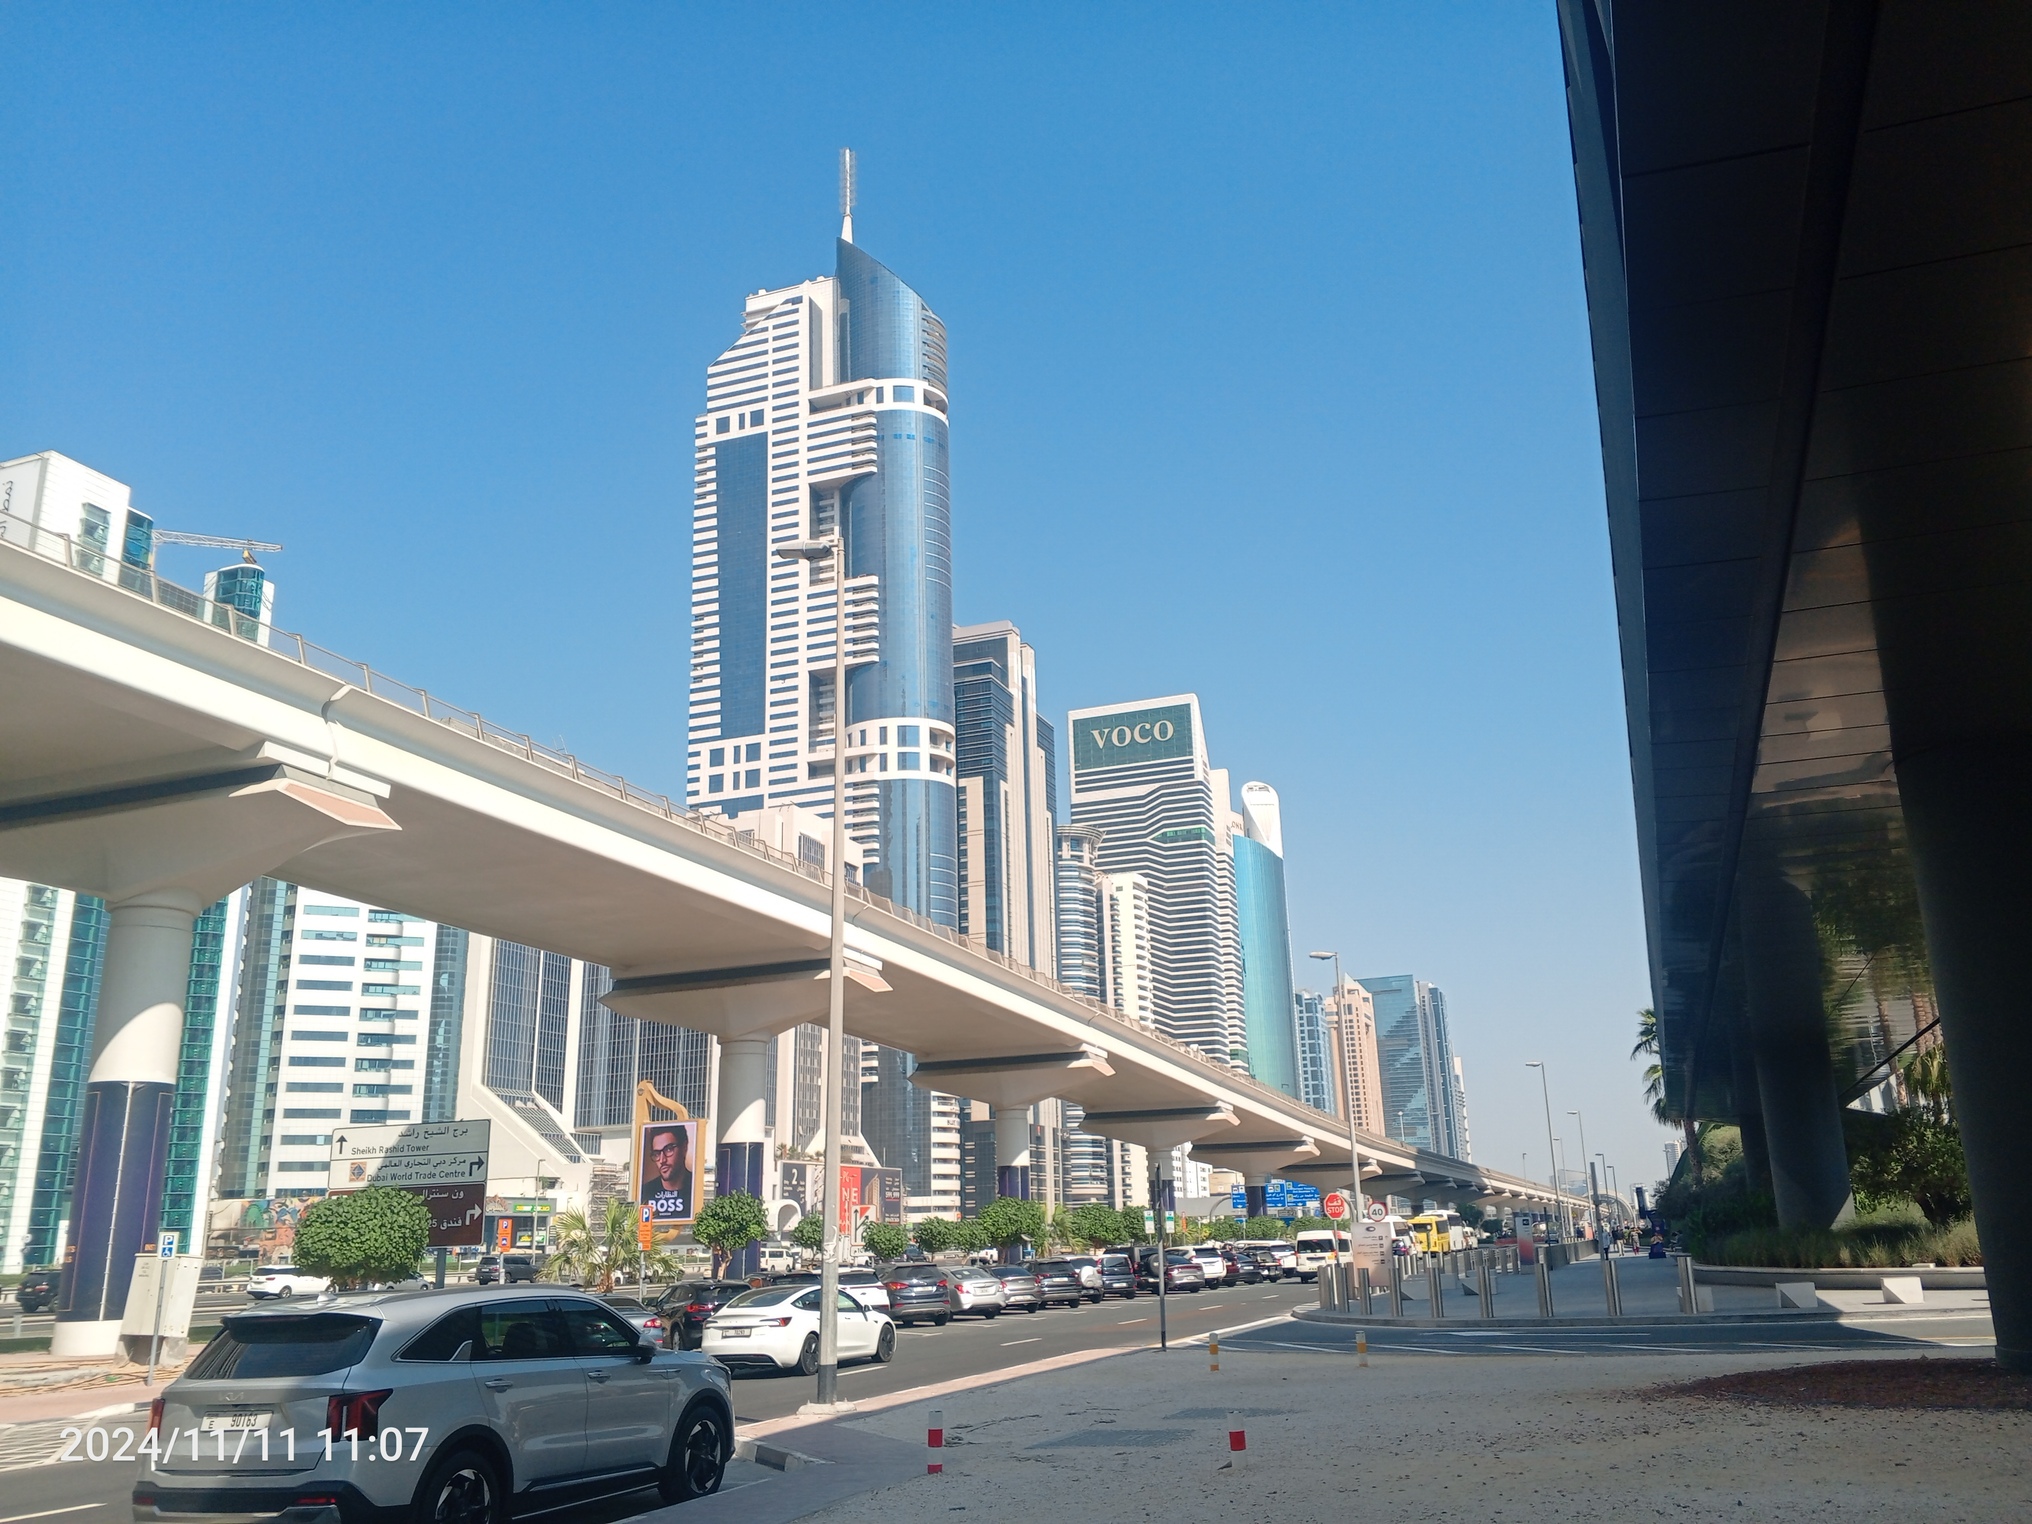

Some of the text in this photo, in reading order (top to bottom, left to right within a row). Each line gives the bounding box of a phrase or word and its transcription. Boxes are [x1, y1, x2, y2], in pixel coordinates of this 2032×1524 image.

[398, 1126, 469, 1140] برج الشيخ راشد
[351, 1144, 430, 1156] Sheikh Rashid Tower
[377, 1157, 467, 1171] مركز دبي التجاري العالمي
[366, 1169, 466, 1182] Dubai World Trade Centre
[648, 1198, 684, 1212] BOSS
[1326, 1206, 1345, 1215] STOP
[1371, 1208, 1384, 1216] 40
[440, 1217, 463, 1231] فندق
[208, 1420, 215, 1429] E
[231, 1413, 258, 1428] 90163
